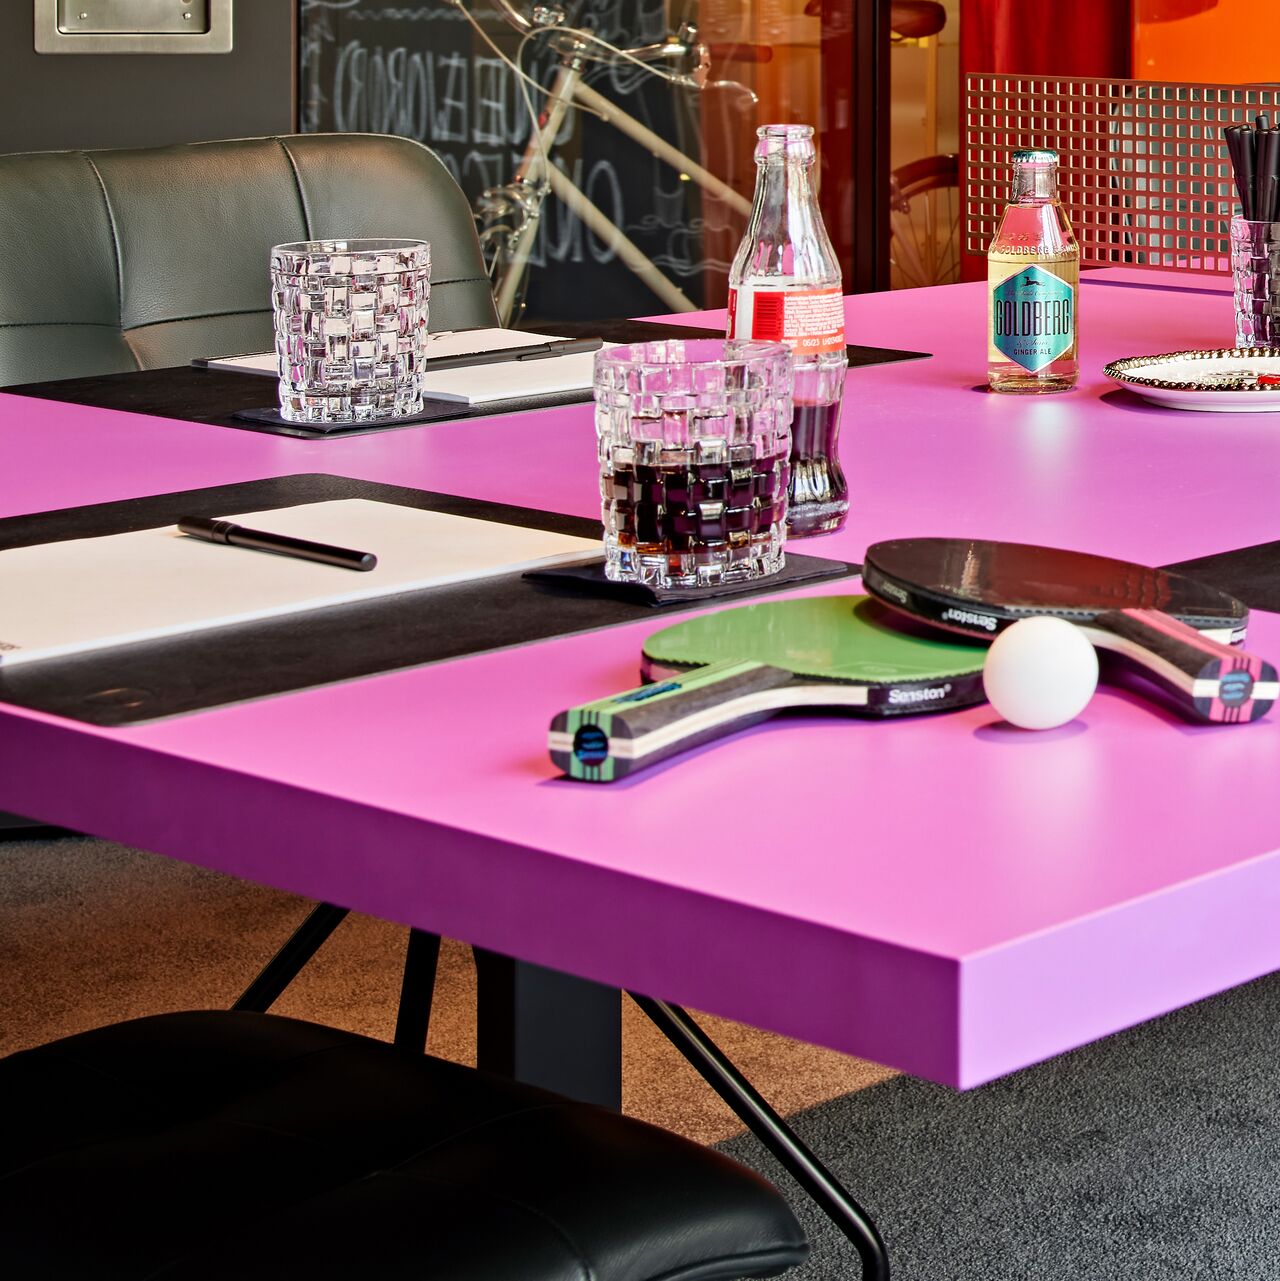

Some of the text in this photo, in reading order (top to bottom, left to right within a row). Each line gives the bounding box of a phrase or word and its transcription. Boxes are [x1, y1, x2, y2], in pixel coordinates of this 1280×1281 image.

[995, 299, 1070, 337] GOLDBERG
[1013, 347, 1052, 356] GINGER ALE
